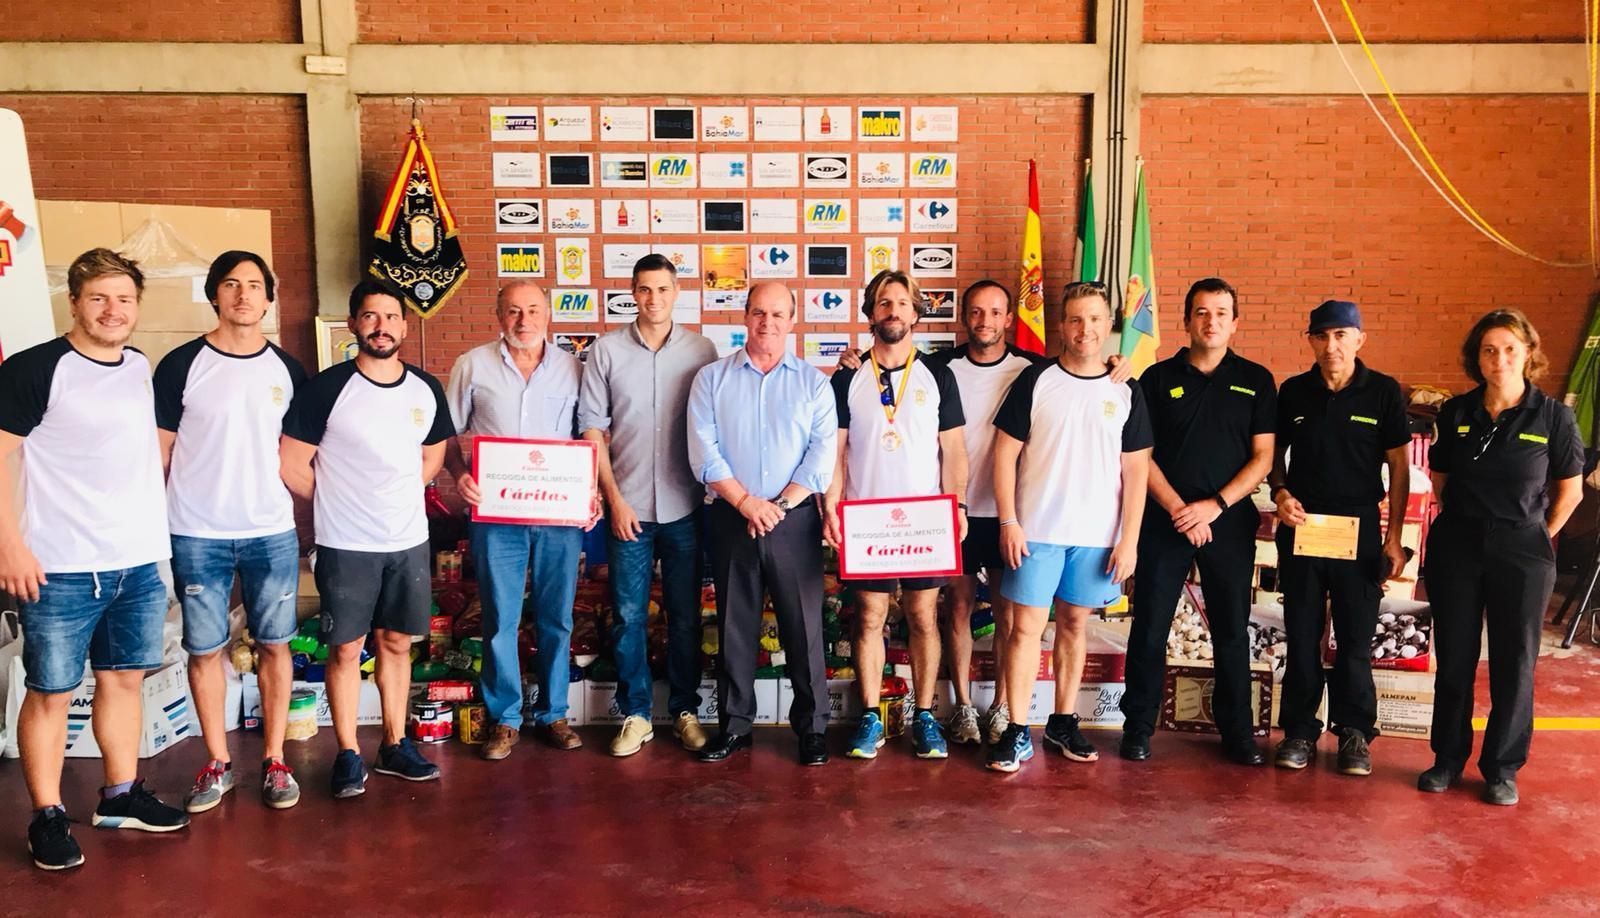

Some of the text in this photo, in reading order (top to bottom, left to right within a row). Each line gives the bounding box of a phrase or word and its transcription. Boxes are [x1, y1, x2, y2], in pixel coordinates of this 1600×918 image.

[861, 111, 901, 136] makro
[658, 158, 688, 176] RM
[918, 158, 948, 176] RM
[812, 204, 841, 221] RM
[912, 221, 954, 230] Carrefour
[500, 247, 539, 272] makro
[753, 267, 794, 275] Carrefour
[559, 294, 589, 311] RM
[806, 312, 848, 320] Carrefour
[925, 307, 937, 315] 5.0
[486, 472, 584, 483] RECOGIDA DE ALIMENTOS
[500, 486, 569, 502] Cáritas
[852, 527, 947, 540] RECOGIDA DE ALIMENTOS
[866, 543, 934, 557] Cáritas
[1380, 693, 1417, 701] ALMEPAN
